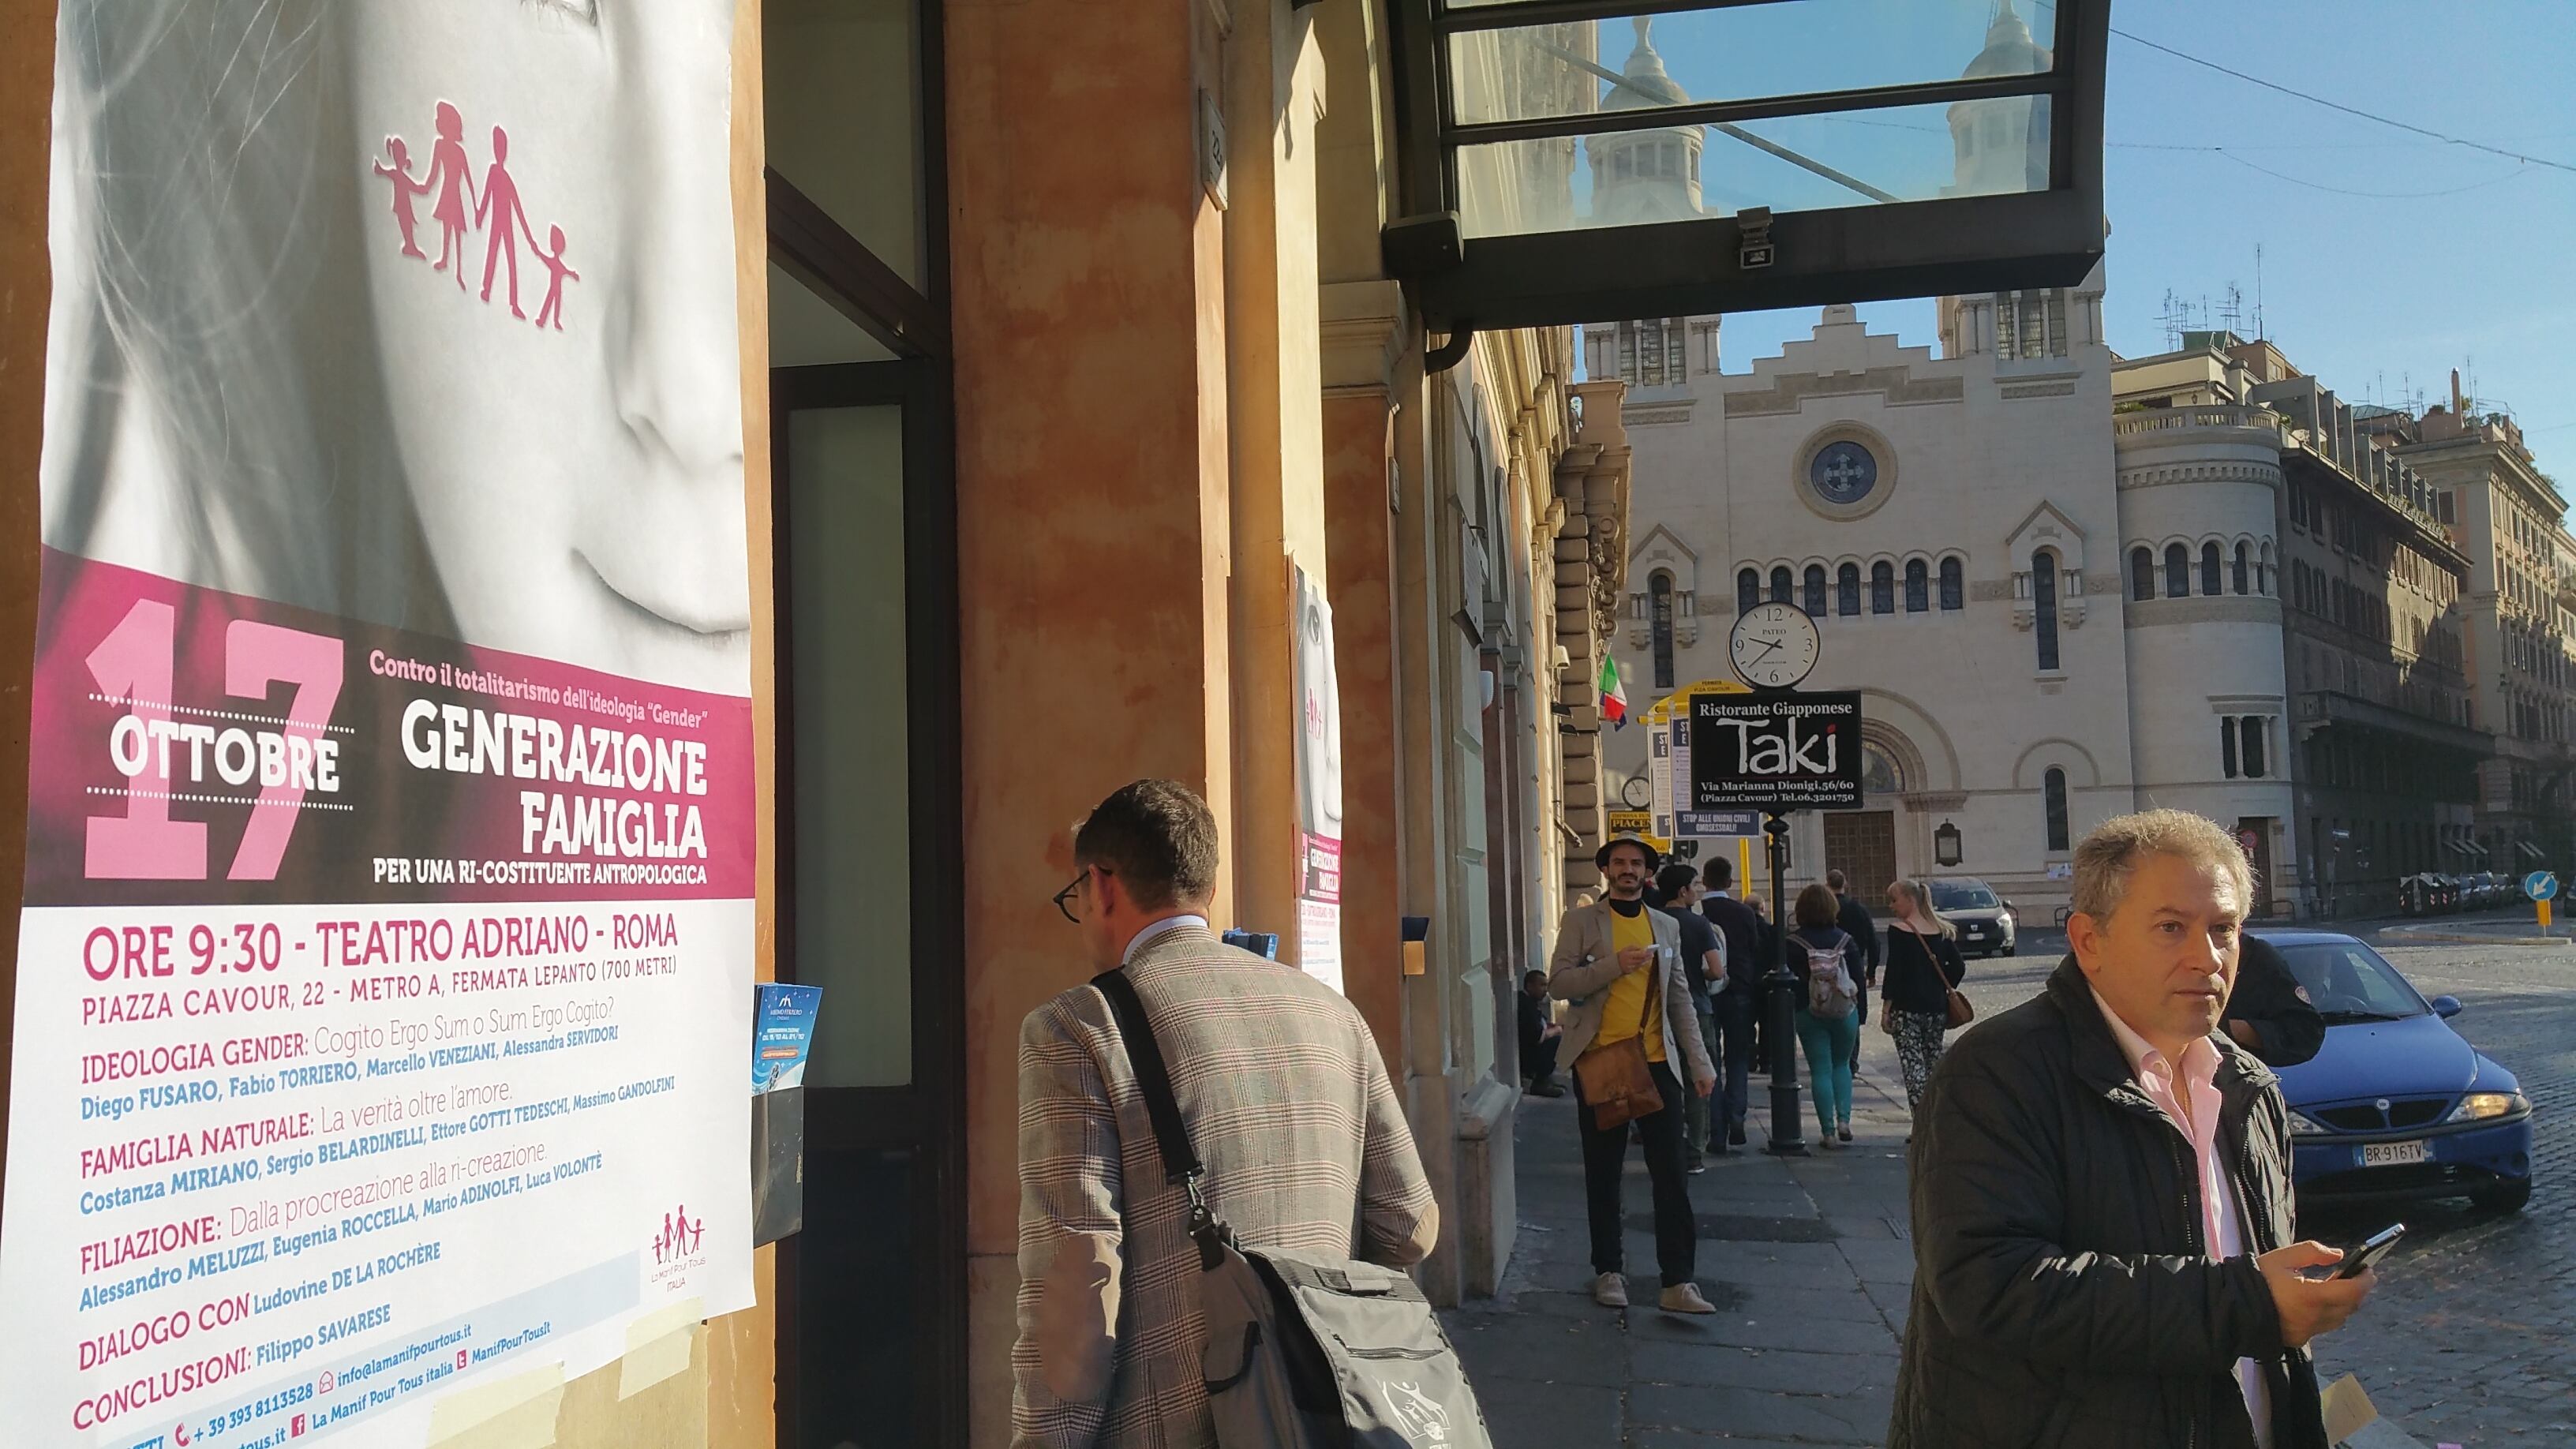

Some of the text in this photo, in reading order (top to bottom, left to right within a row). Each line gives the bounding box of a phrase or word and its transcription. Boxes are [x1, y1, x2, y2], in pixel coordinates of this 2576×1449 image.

[1735, 638, 1813, 651] 9 3
[1767, 608, 1783, 621] 12
[369, 650, 436, 684] Contro
[440, 663, 451, 687] il
[455, 667, 560, 705] totalitarismo
[564, 686, 645, 723] dell'ideologia
[1699, 701, 1852, 719] Ristorante Giapponese
[1769, 670, 1778, 683] 6
[83, 597, 344, 881] 17
[110, 715, 339, 792] OTTOBRE
[401, 698, 707, 796] GENERAZIONE
[1661, 746, 1665, 754] E
[1682, 734, 1686, 744] E
[1716, 717, 1837, 775] Taki
[1683, 814, 1750, 822] STOP ALLE UNIONI CIVILI
[1701, 781, 1854, 792] Via Marianna Dionigi,56/60
[1701, 792, 1855, 804] (Piazza Cavour) Tel.06.3201750
[520, 790, 708, 859] FAMIGLIA
[373, 857, 707, 885] PER UNA RI-COSTITUENTE ANTROPOLOGICA
[83, 926, 174, 981] ORE
[189, 923, 281, 976] 9:30
[316, 919, 453, 967] TEATRO
[462, 915, 588, 960] ADRIANO
[612, 913, 678, 949] ROMA
[82, 993, 173, 1025] PIAZZA
[184, 984, 295, 1017] CAVOUR,
[303, 982, 324, 1006] 22
[350, 975, 421, 1002] METRO
[428, 975, 445, 998] A,
[452, 968, 528, 994] FERMATA
[535, 962, 596, 987] LEPANTO
[602, 959, 630, 981] (700
[635, 955, 677, 977] METRI)
[81, 996, 614, 1084] IDEOLOGIA GENDER: Cogito Ergo Sum o Sum Ergo Cogito?
[81, 1025, 619, 1121] Diego FUSARO, Fabio TORRIERO, Marcello VENEZIANI, Alessandra SERVIDORI
[80, 1082, 512, 1179] FAMIGLIA NATURALE: La verità oltre l'amore.
[80, 1076, 675, 1215] Costanza MIRIANO, Sergio BELARDINELLI, Ettore GOTTI TEDESCHI, Massimo GANDOLFINI
[80, 1143, 547, 1275] FILIAZIONE: Dalla procreazione alla ri-creazione.
[80, 1150, 602, 1312] Alessandro MELUZZI, Eugenia ROCCELLA, Mario ADINOLFI, Luca VOLONTÈ
[79, 1242, 440, 1371] DIALOGO CON Ludovine DE LA ROCHÈRE
[667, 1277, 686, 1293] ITALIA
[73, 1304, 391, 1430] CONCLUSIONI: Filippo SAVARESE
[208, 1416, 225, 1437] 39
[229, 1404, 251, 1430] 393
[256, 1383, 313, 1418] 8113528
[338, 1324, 471, 1387] info@lamanifpourtous.it
[313, 1413, 328, 1429] La
[331, 1395, 366, 1421] Manif
[370, 1387, 396, 1406] Pour
[398, 1373, 423, 1394] Tous
[426, 1362, 452, 1383] italia
[472, 1322, 550, 1364] ManifPourTousIt
